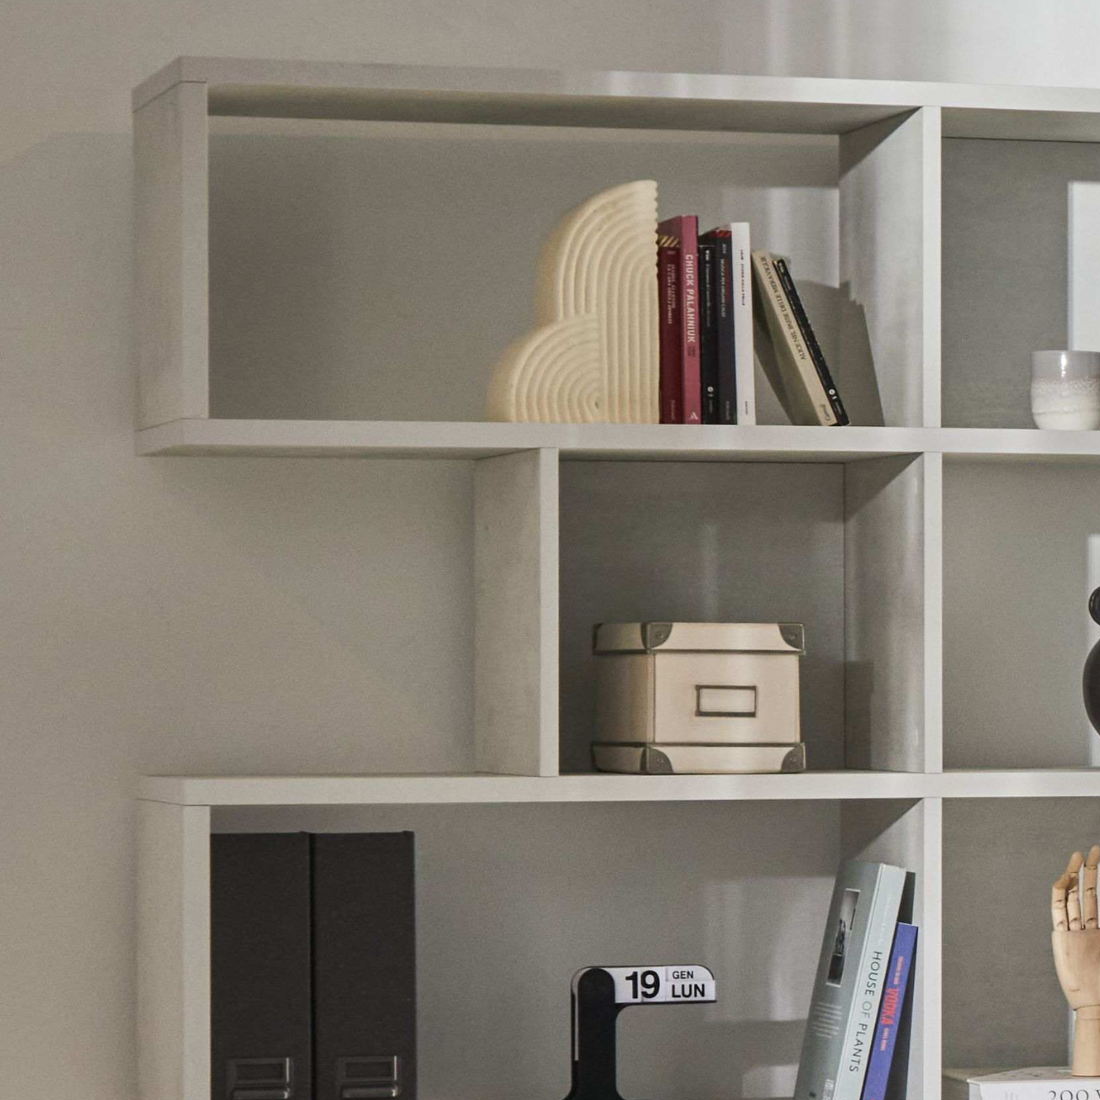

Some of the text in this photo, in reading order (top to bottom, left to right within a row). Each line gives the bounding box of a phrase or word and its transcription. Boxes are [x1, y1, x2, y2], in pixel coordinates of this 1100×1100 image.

[685, 254, 695, 286] CHUCK
[686, 289, 696, 342] PALAHNIUK
[625, 970, 660, 999] 19
[671, 983, 706, 998] LUN
[672, 970, 694, 980] GEN
[849, 951, 883, 1072] HOUSE OF PLANTS
[881, 988, 899, 1025] VODKA
